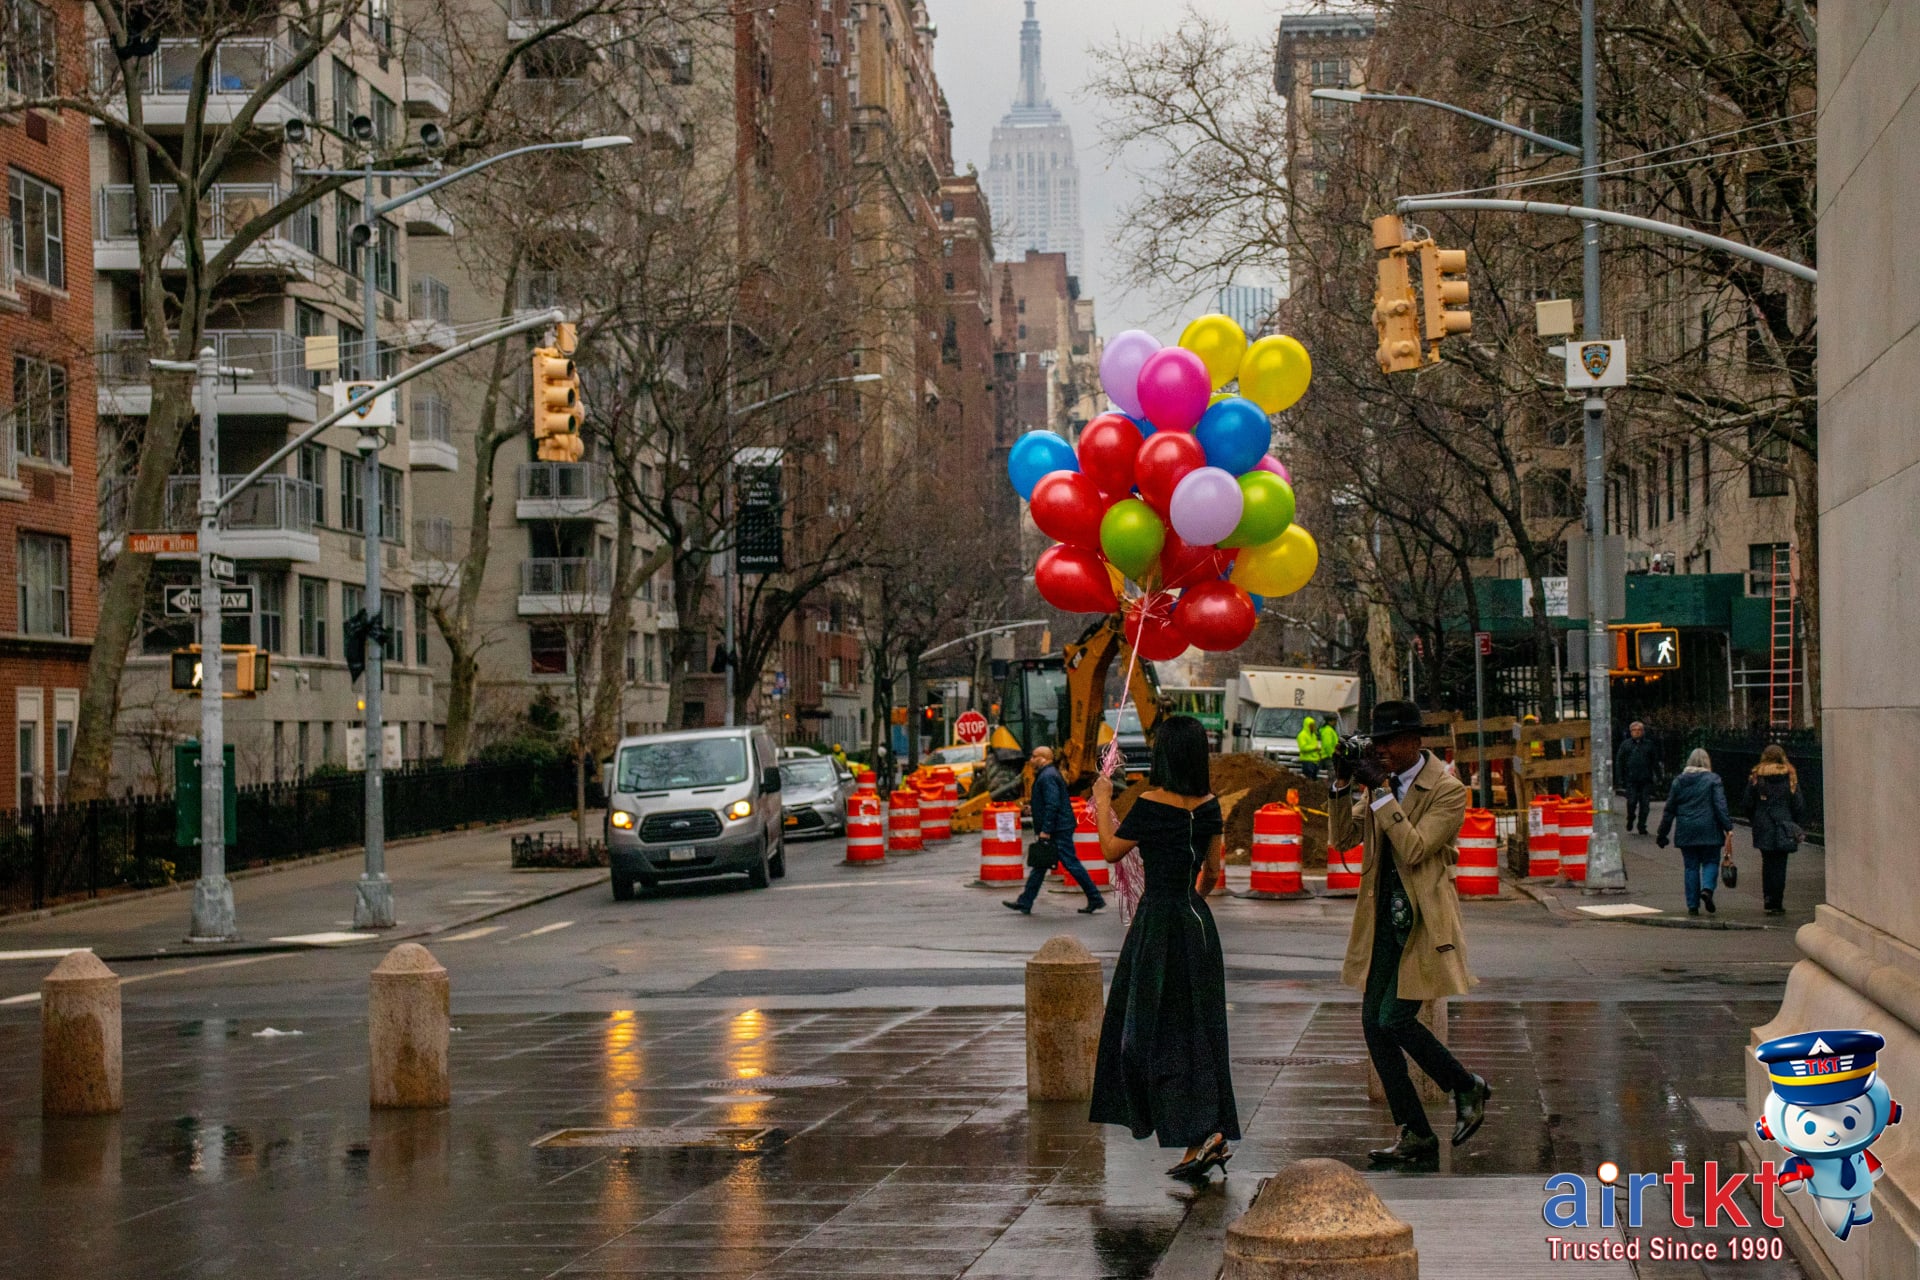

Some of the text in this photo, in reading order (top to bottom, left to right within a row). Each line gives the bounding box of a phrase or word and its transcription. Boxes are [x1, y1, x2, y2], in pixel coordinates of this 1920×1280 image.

[134, 539, 195, 551] SQUARE NORTH
[740, 555, 778, 563] COMPASS
[958, 721, 985, 736] STOP
